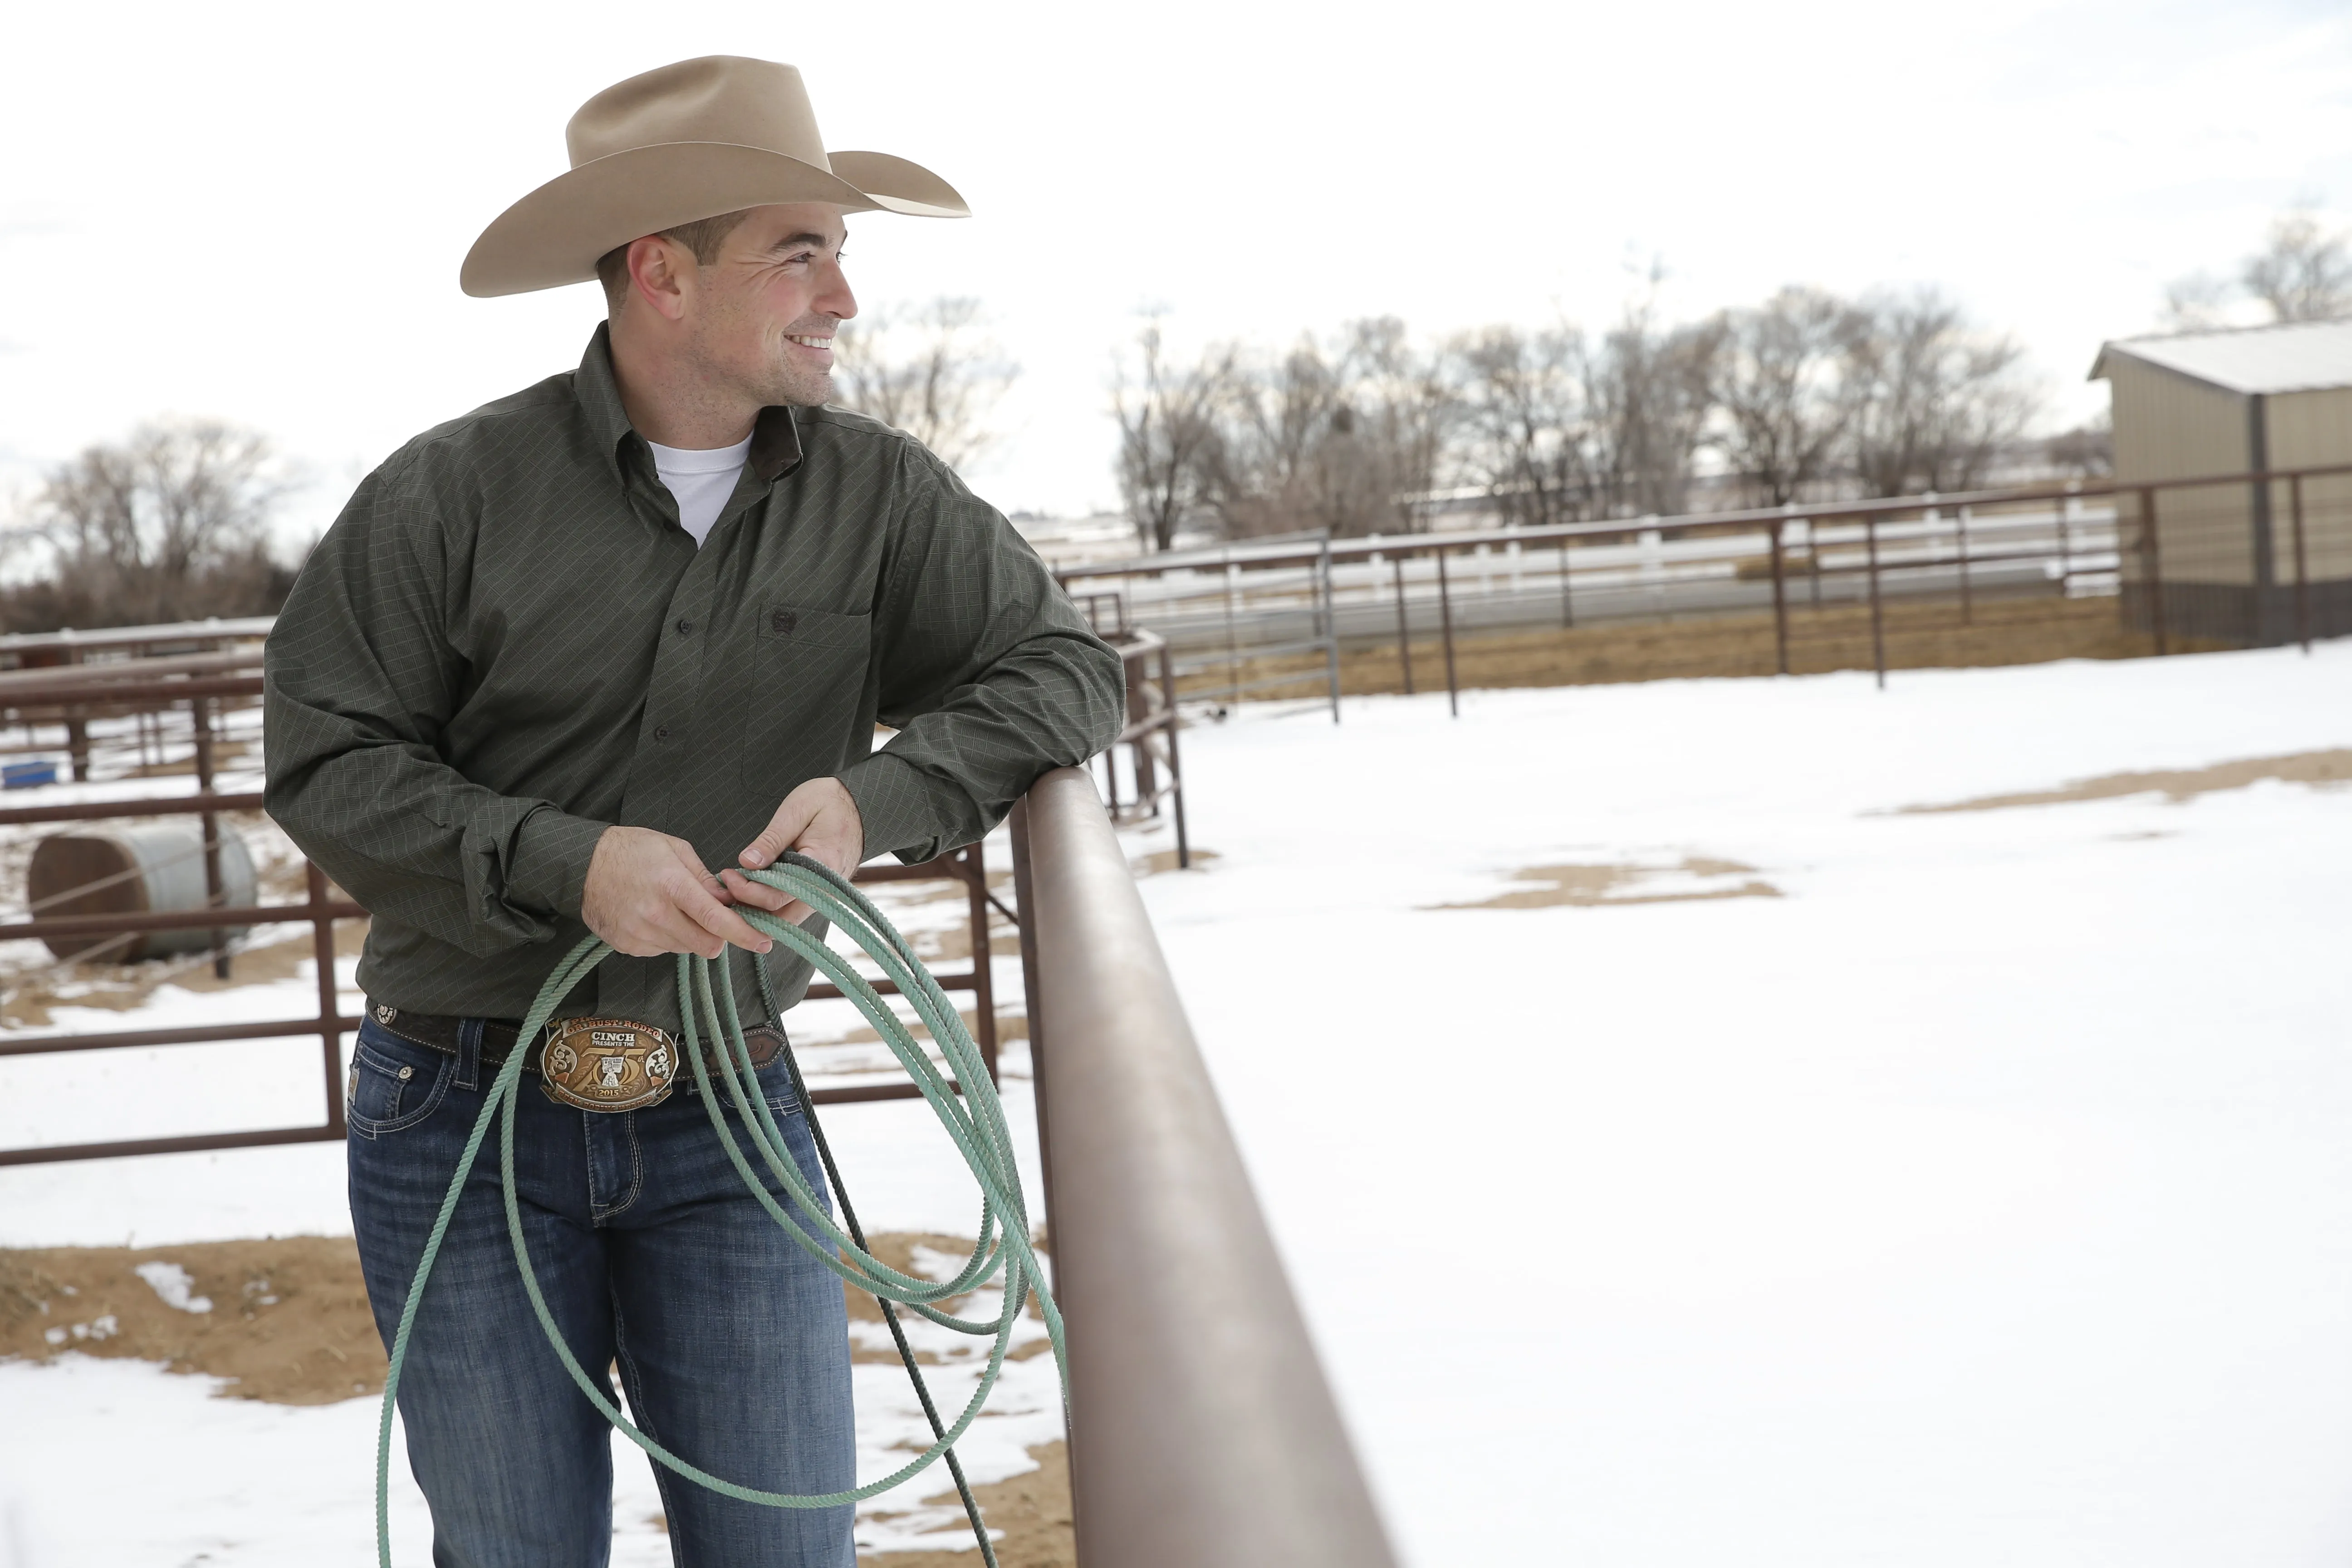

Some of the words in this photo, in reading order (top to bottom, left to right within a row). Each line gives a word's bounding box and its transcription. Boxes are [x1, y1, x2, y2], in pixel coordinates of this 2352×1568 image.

[567, 1024, 583, 1034] OR
[623, 1020, 659, 1037] RODEO
[591, 1032, 635, 1041] CINCH
[559, 1090, 581, 1104] TEAM
